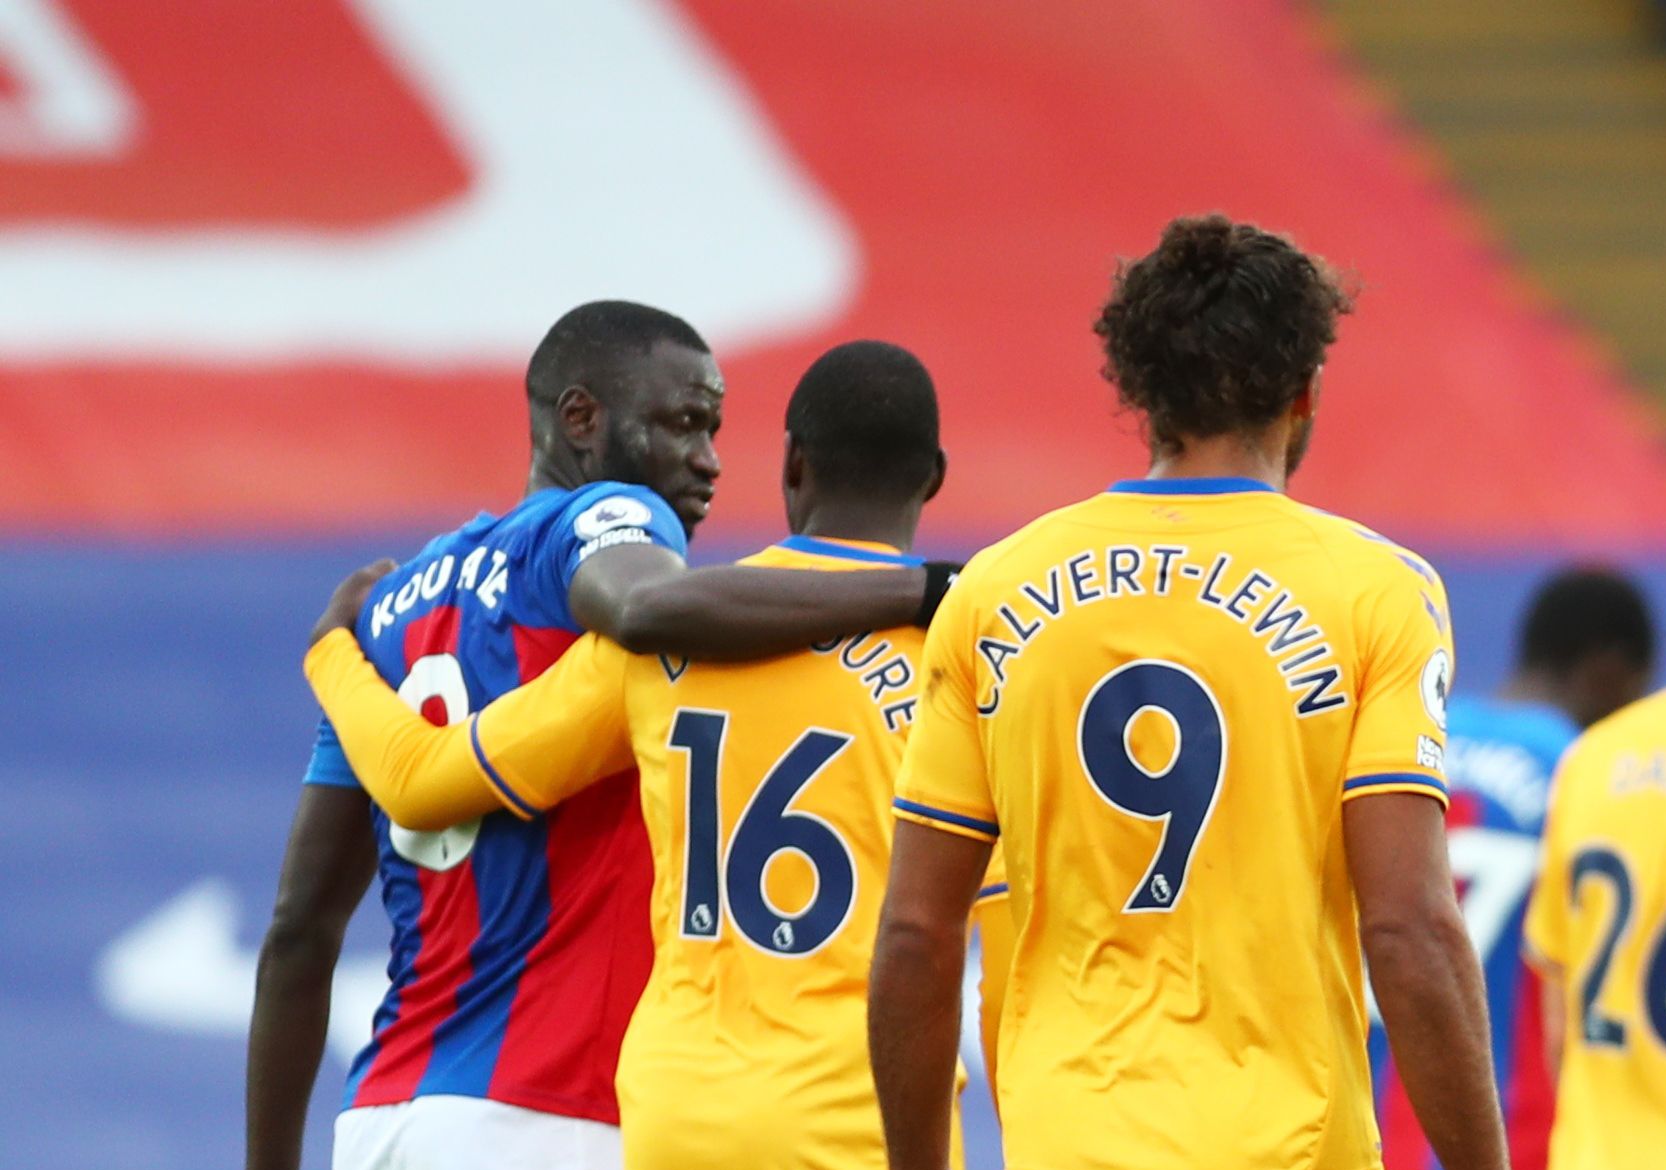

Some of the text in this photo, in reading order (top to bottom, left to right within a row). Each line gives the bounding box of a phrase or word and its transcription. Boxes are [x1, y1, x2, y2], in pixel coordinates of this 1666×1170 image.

[975, 545, 1348, 719] CALVERT-LEWIN
[668, 707, 855, 958] 16
[1076, 658, 1228, 913] 9
